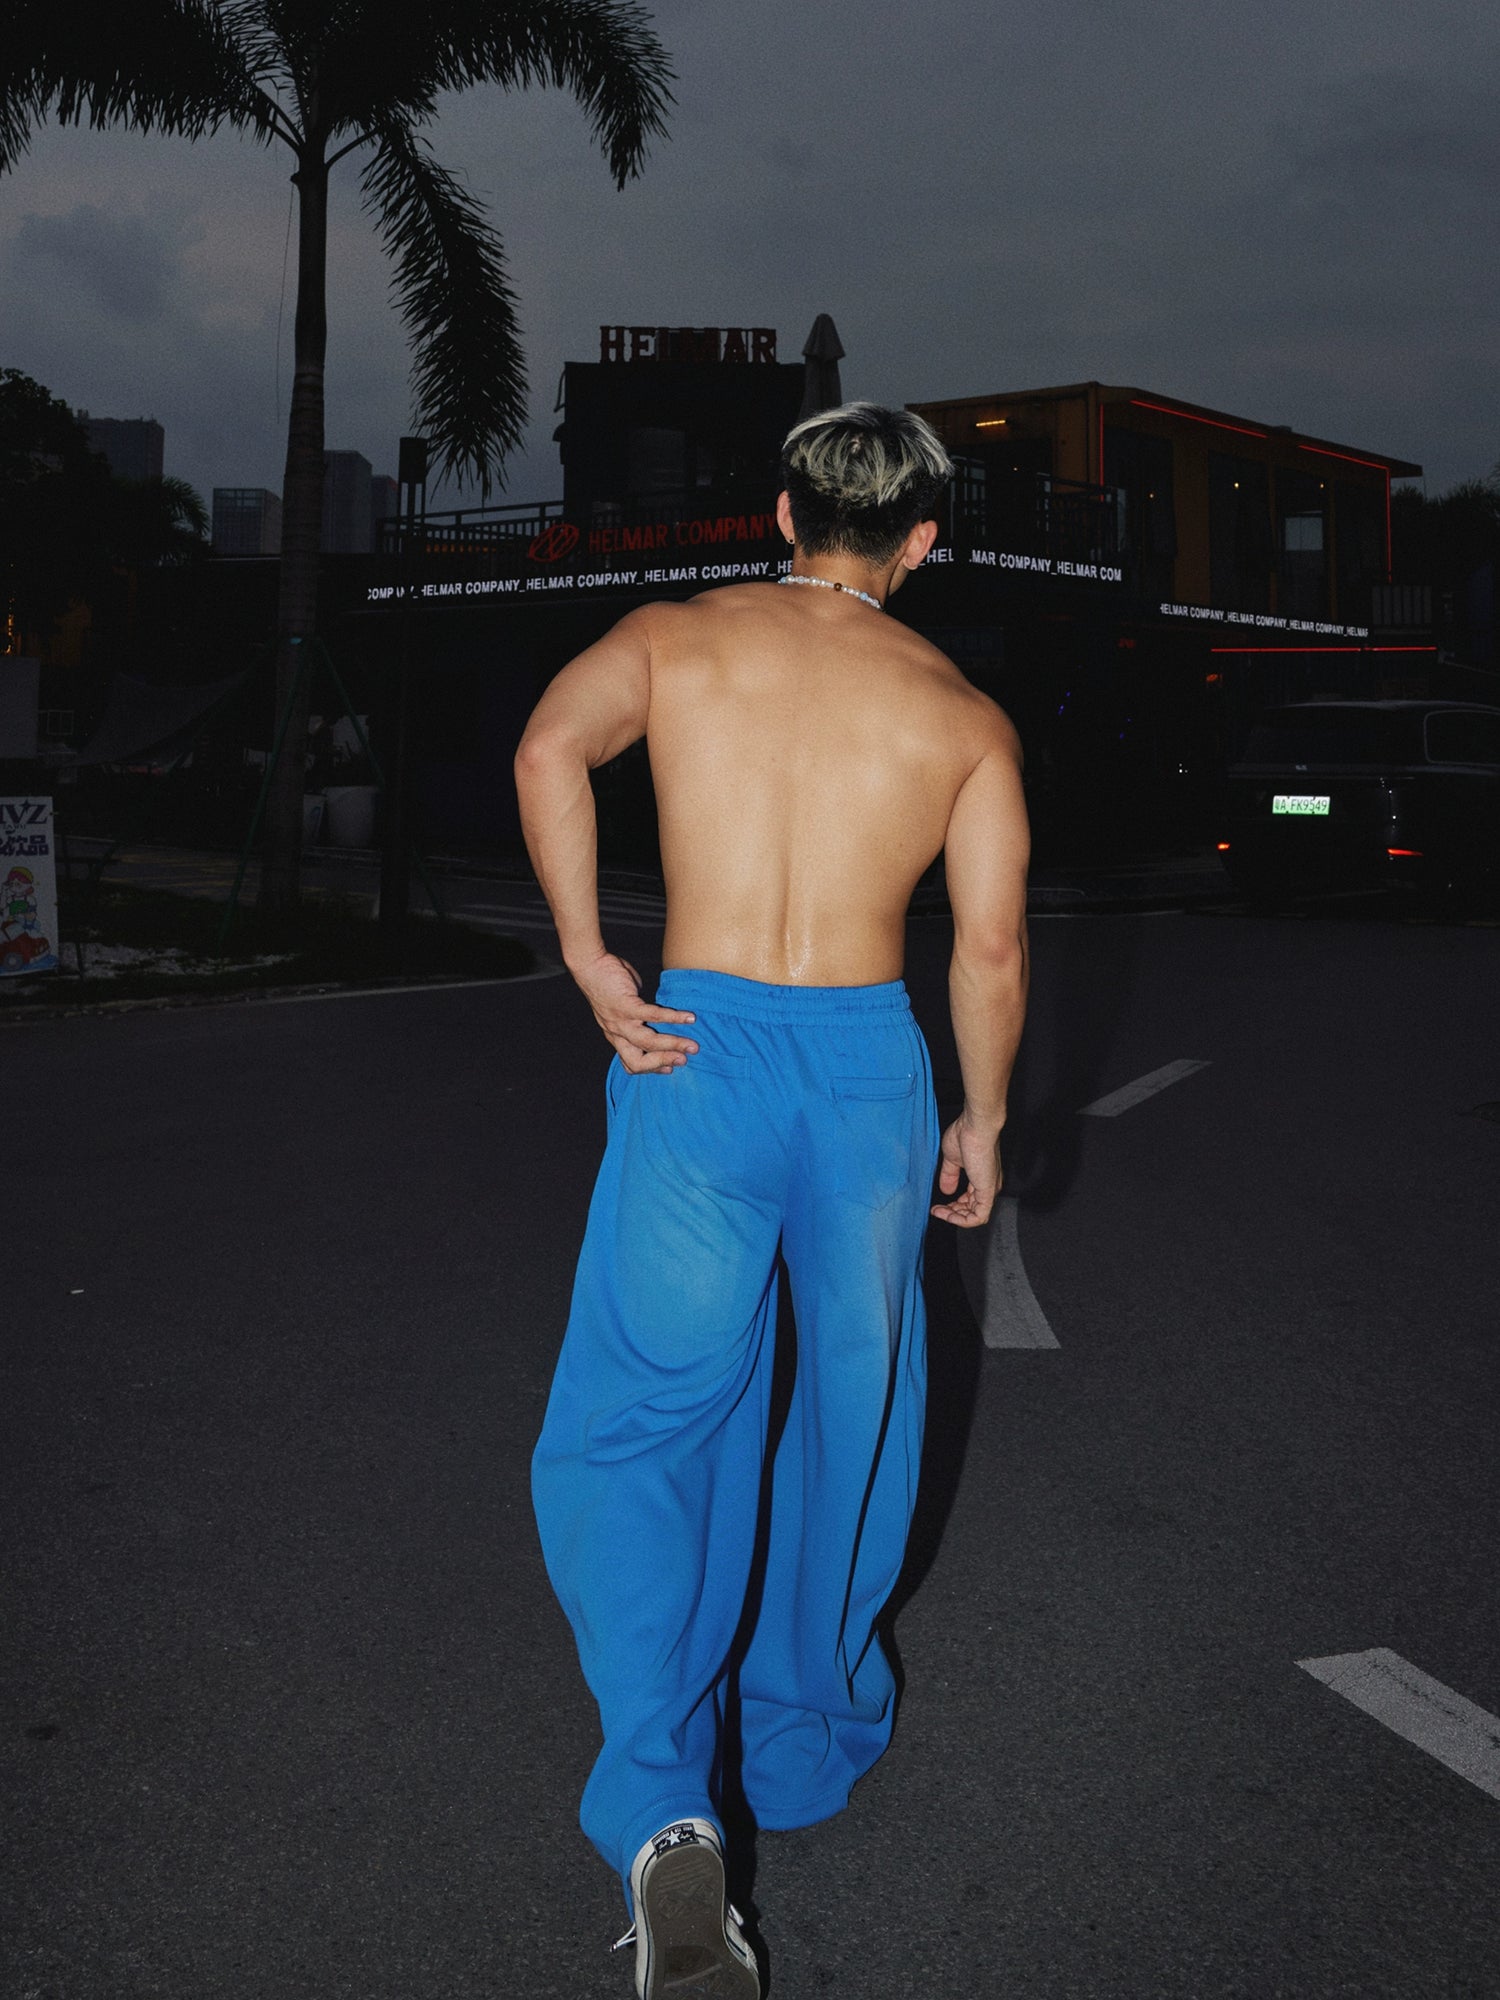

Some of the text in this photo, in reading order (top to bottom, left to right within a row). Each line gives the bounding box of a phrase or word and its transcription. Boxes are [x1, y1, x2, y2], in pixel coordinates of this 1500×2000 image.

[600, 326, 776, 363] HELMAR
[588, 513, 778, 554] HELMAR COMPANY
